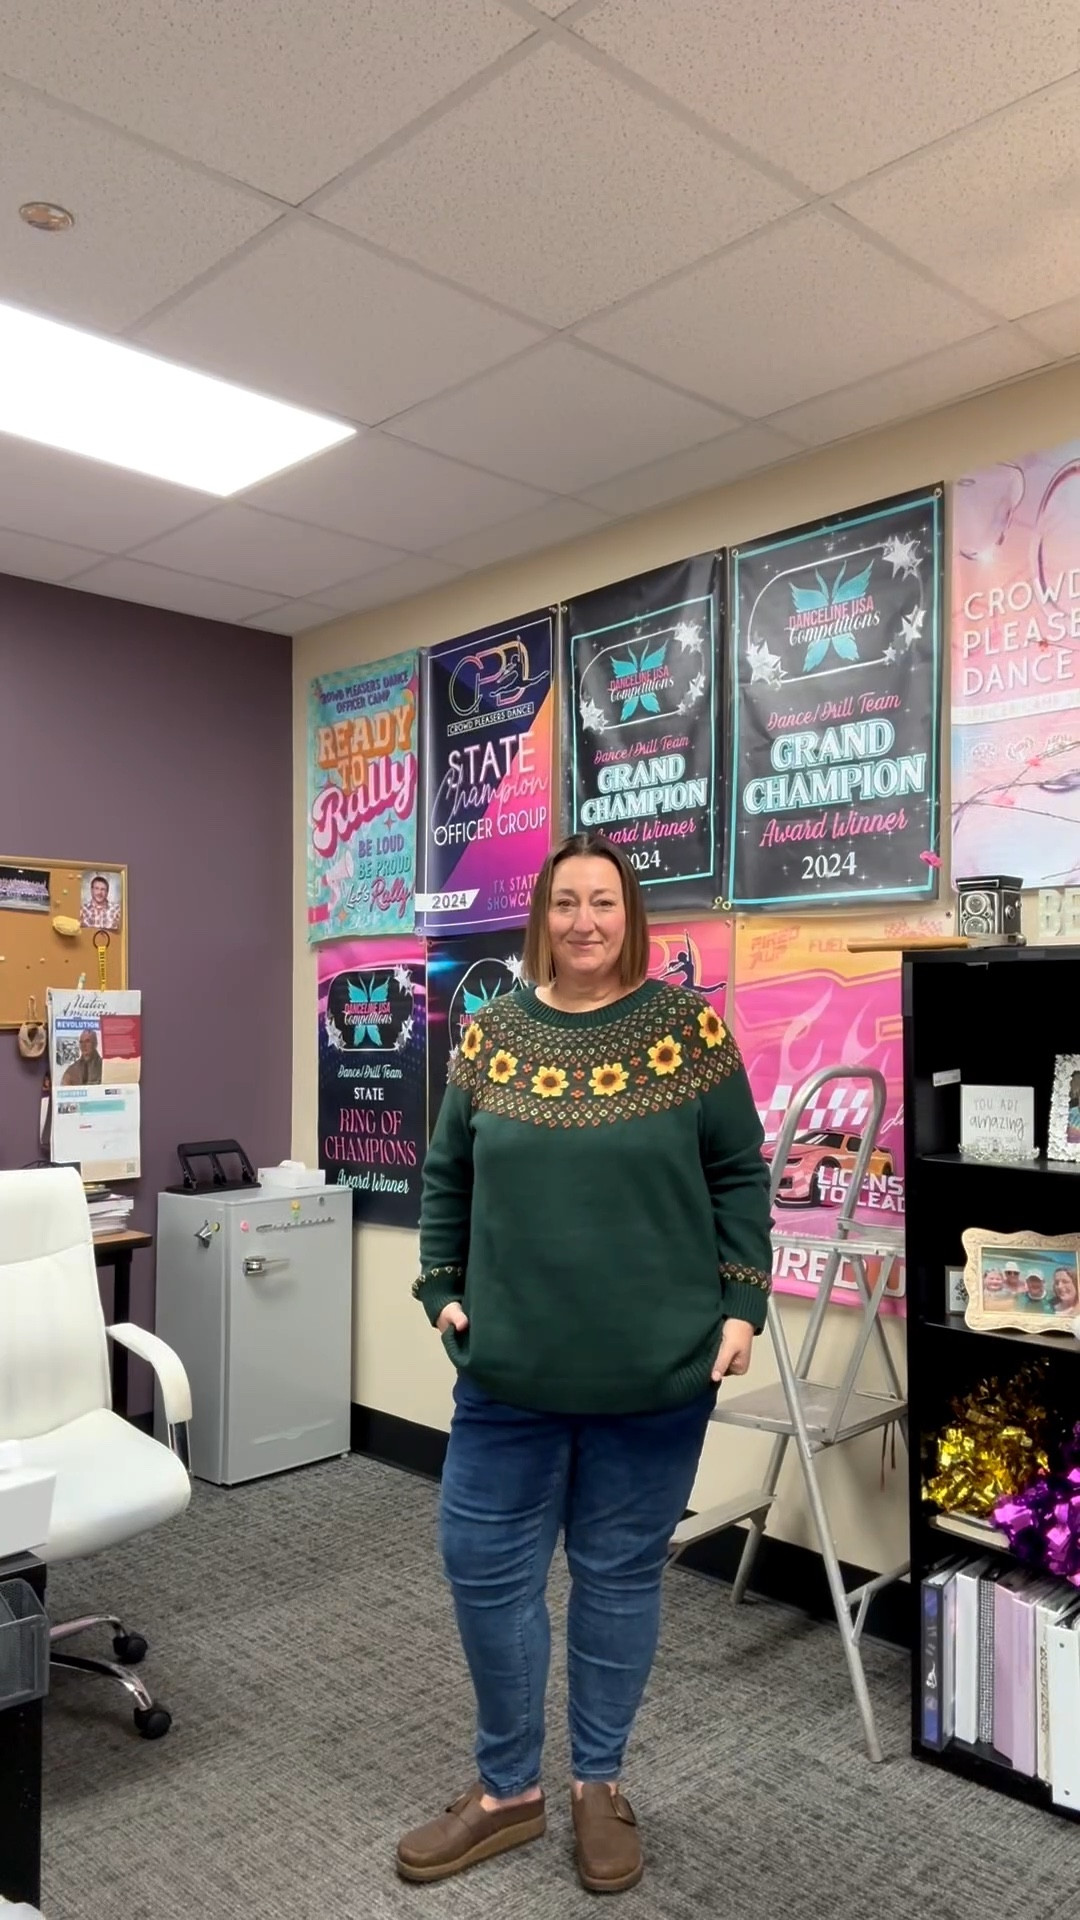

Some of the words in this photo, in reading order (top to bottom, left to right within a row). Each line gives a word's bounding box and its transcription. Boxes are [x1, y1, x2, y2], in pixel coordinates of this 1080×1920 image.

[788, 602, 849, 630] DANCELINE
[851, 595, 875, 617] USA
[785, 611, 881, 647] Competitions
[344, 678, 382, 699] PLEASERS
[383, 670, 409, 688] DANCE
[610, 672, 652, 691] DANCELINE
[653, 665, 671, 681] USA
[962, 651, 1075, 697] DANCE
[336, 695, 367, 714] OFFICER
[368, 689, 391, 706] CAMP
[608, 676, 675, 703] Competitions
[857, 691, 902, 714] Team
[449, 720, 474, 735] CROWD
[474, 712, 506, 728] PLEASERS
[506, 704, 532, 720] DANCE
[316, 705, 414, 768] READY
[660, 734, 690, 750] Team
[771, 718, 896, 773] GRAND
[448, 731, 535, 788] STATE
[597, 753, 686, 794] GRAND
[338, 755, 367, 794] TO
[743, 753, 927, 815] CHAMPION
[312, 752, 417, 857] Rally
[431, 768, 548, 832] Champion
[581, 777, 708, 826] CHAMPION
[434, 818, 493, 847] OFFICER
[496, 806, 548, 836] GROUP
[642, 817, 697, 842] Winner
[759, 812, 828, 847] Award
[831, 807, 909, 840] Winner
[358, 839, 373, 858] BE
[376, 834, 405, 856] LOUD
[626, 850, 661, 870] 024
[358, 860, 373, 880] BE
[376, 855, 412, 878] PROUD
[801, 851, 858, 880] 2024
[346, 884, 370, 910] Let's
[432, 893, 468, 910] 2024
[379, 1001, 391, 1013] USA
[57, 1021, 100, 1029] REVOLUTION
[382, 1063, 403, 1079] Team
[354, 1087, 384, 1101] STATE
[339, 1107, 376, 1134] RING
[381, 1110, 404, 1135] OF
[969, 1115, 1024, 1140] amazing
[324, 1136, 417, 1167] CHAMPIONS
[336, 1168, 371, 1190] Award
[371, 1172, 410, 1194] Winner
[817, 1184, 846, 1203] TO
